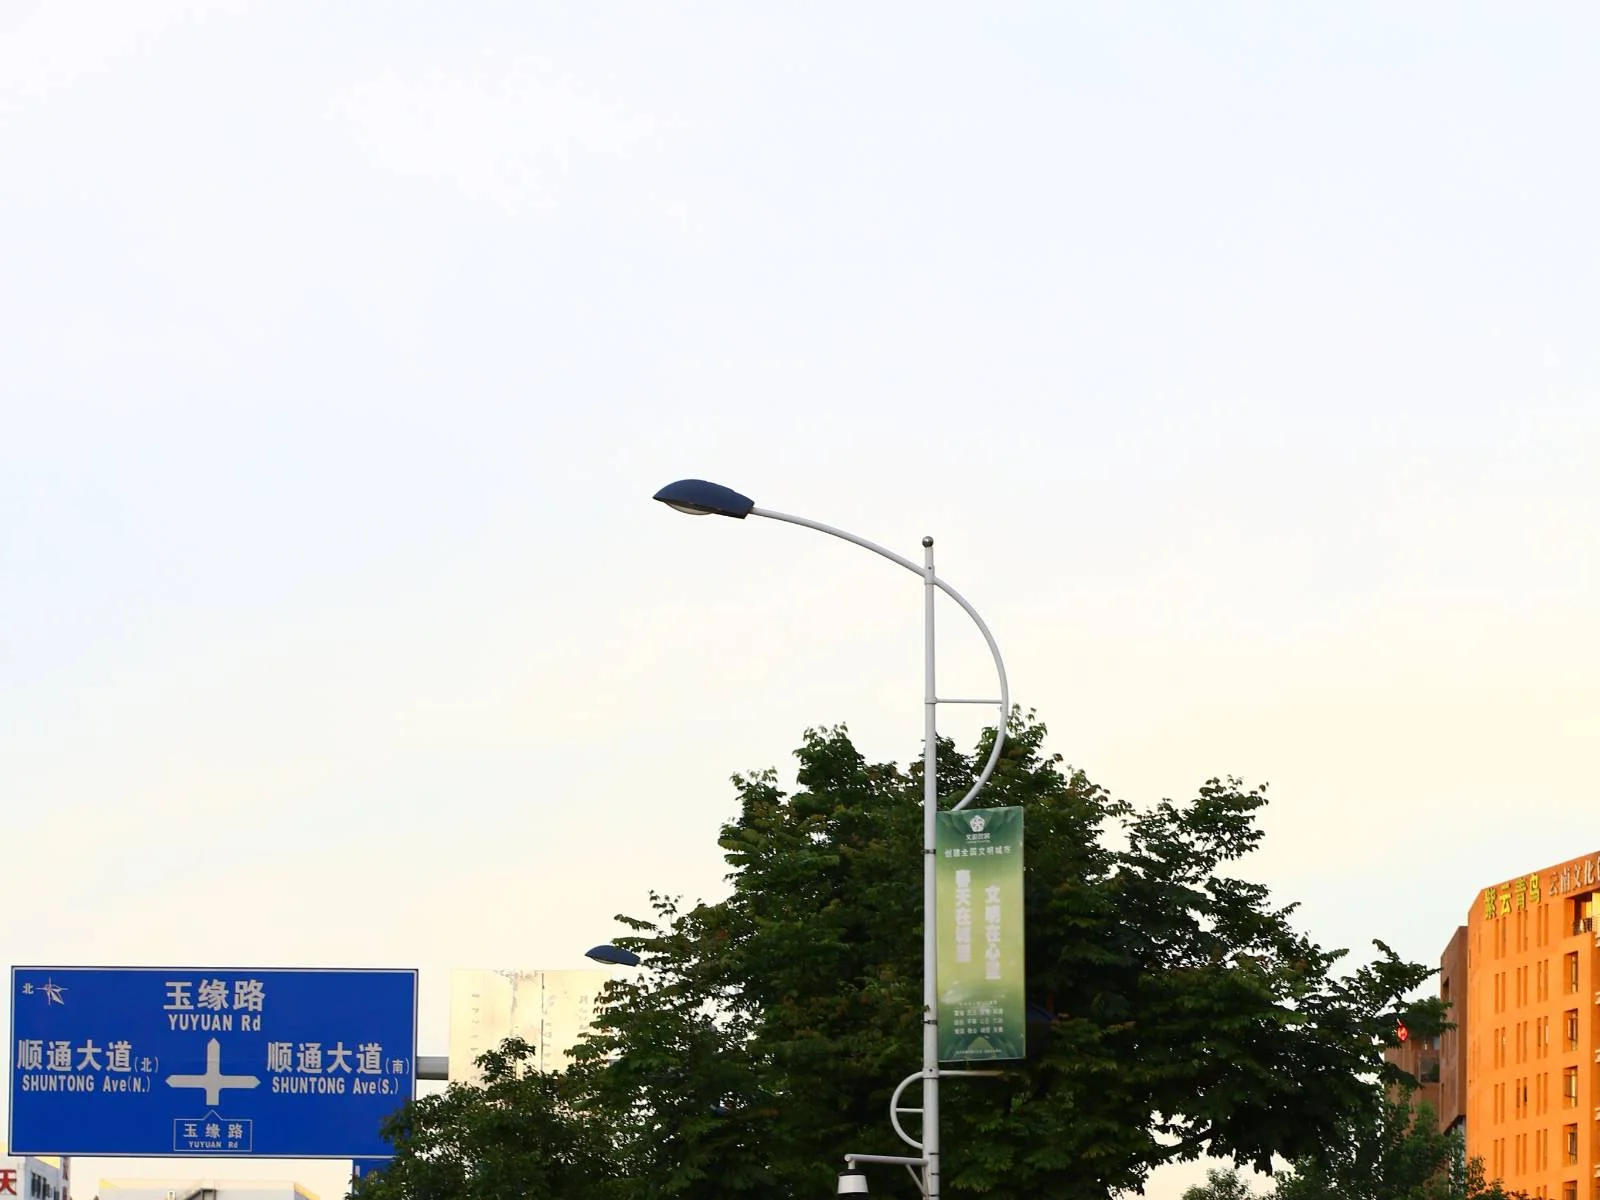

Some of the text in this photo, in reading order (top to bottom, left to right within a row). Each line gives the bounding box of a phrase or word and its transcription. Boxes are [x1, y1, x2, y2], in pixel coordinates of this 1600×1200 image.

[22, 983, 34, 995] 北
[163, 979, 266, 1011] 玉缘路
[168, 1014, 261, 1031] YUYUAN Rd
[22, 1074, 95, 1092] SHUNTONG
[272, 1076, 345, 1094] SHUNTONG
[183, 1123, 243, 1139] 玉缘路
[188, 1141, 238, 1149] YUYUAN Rd
